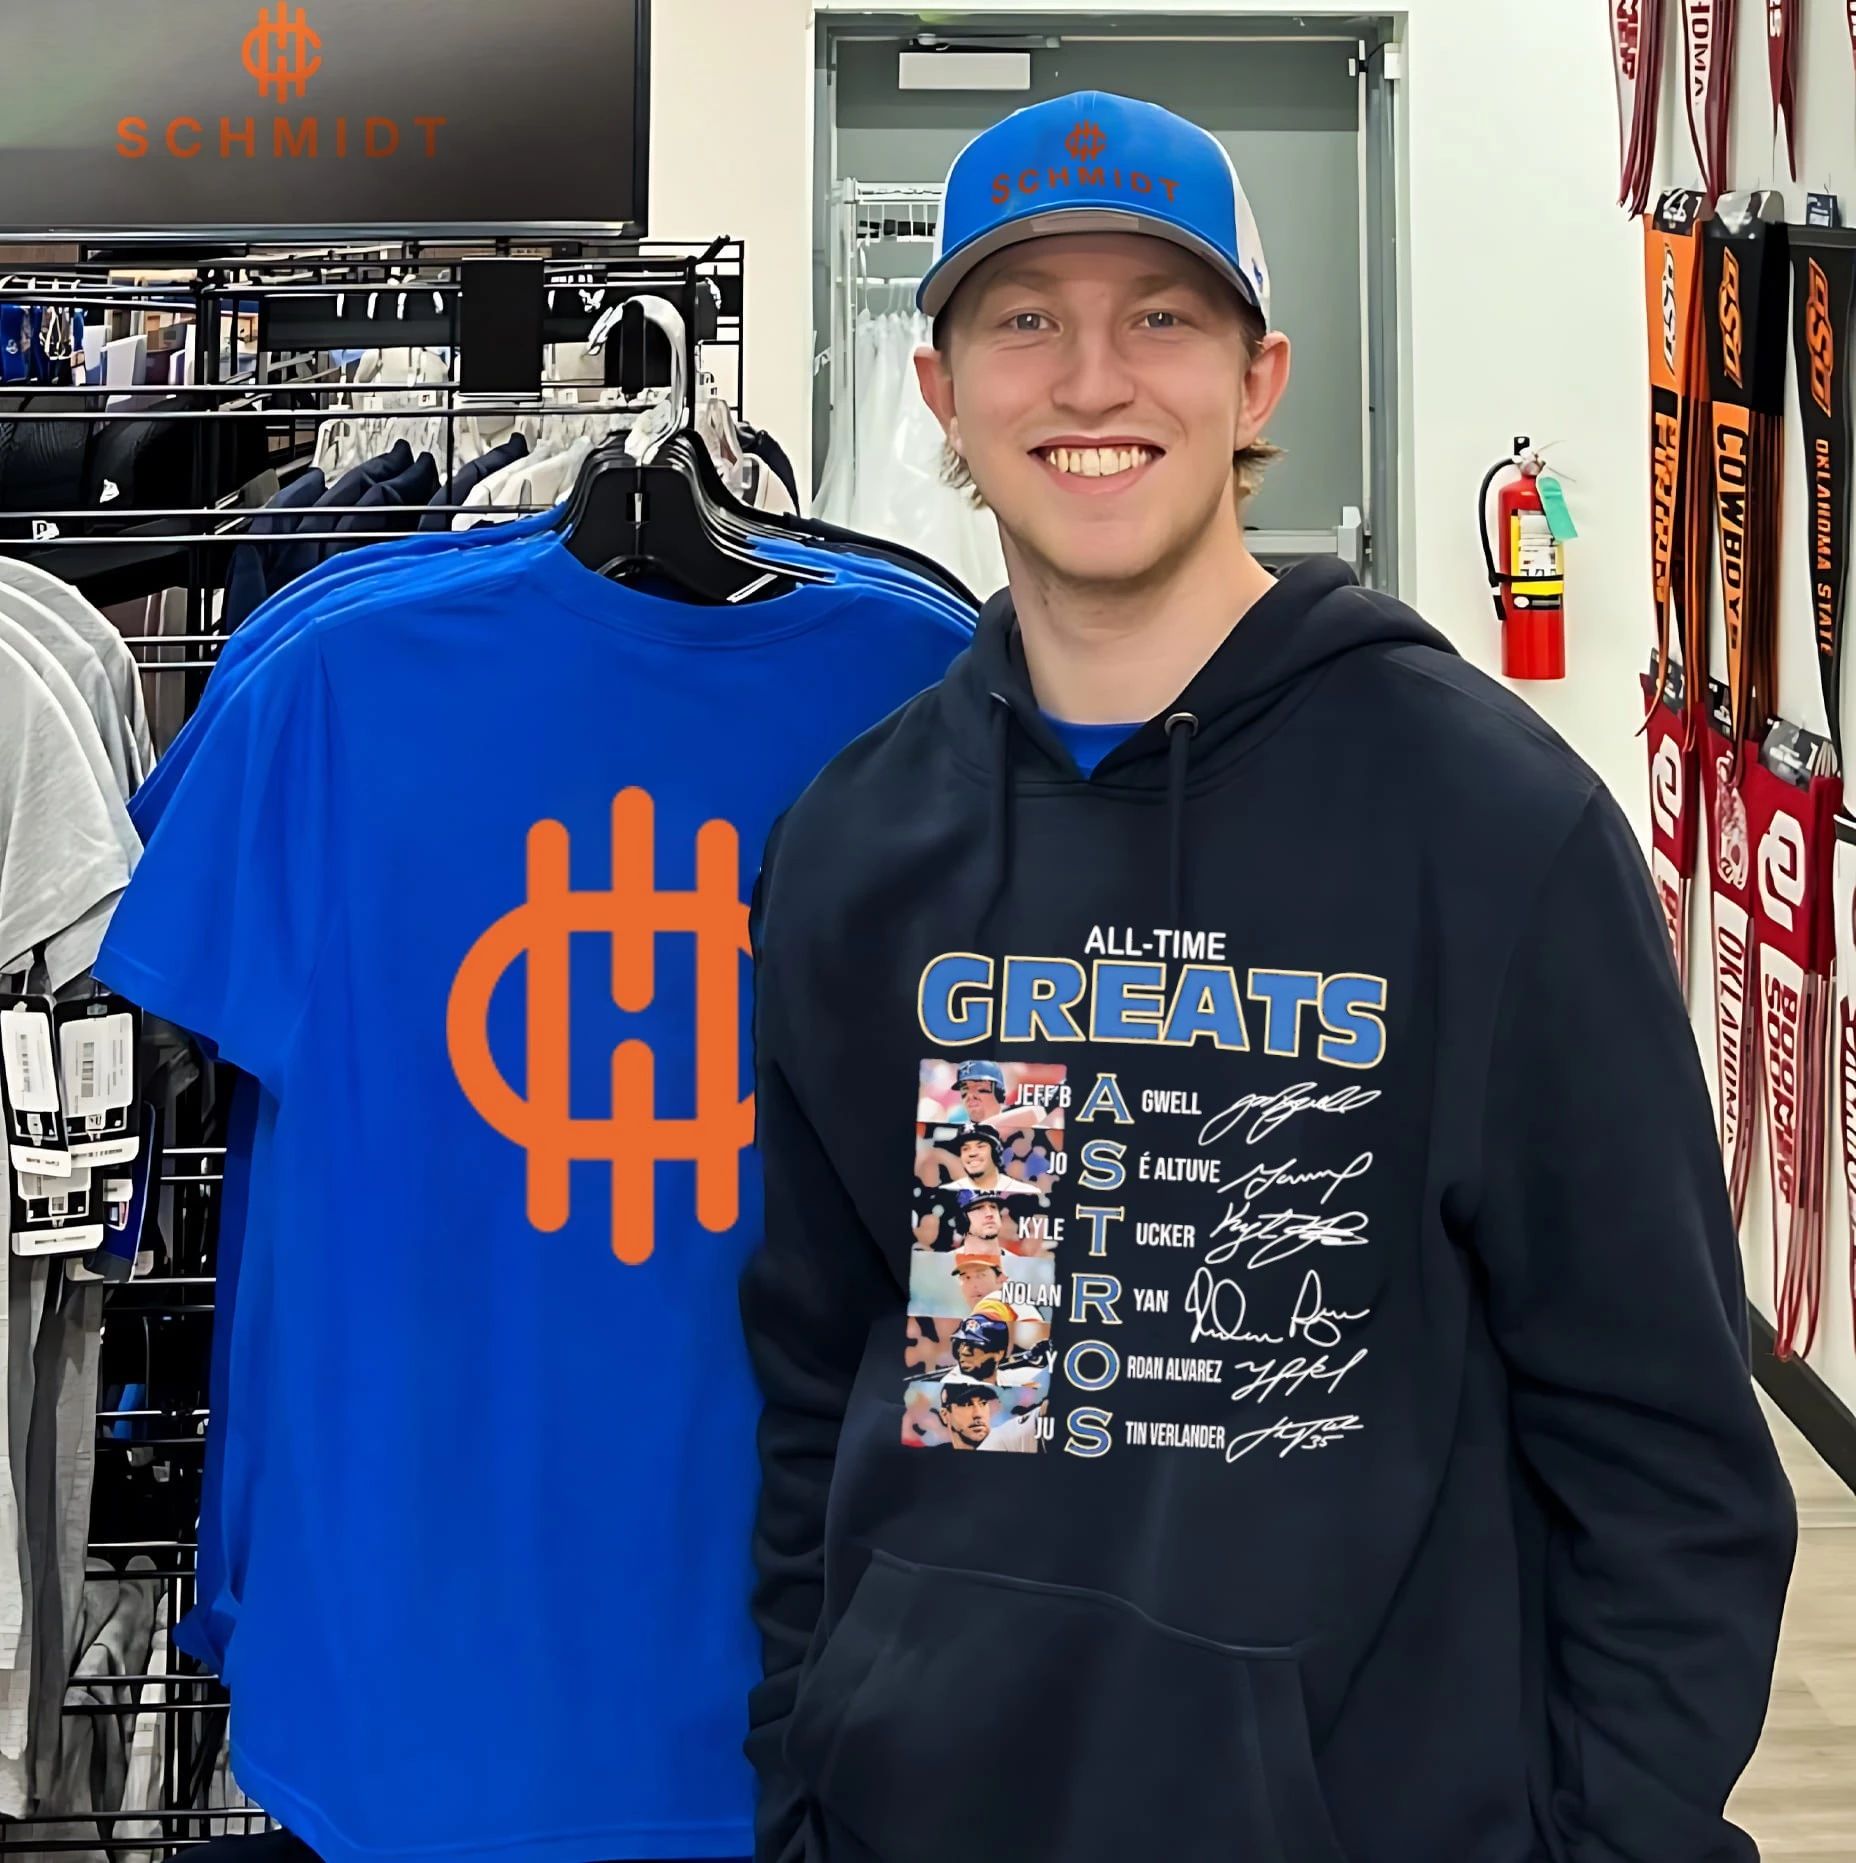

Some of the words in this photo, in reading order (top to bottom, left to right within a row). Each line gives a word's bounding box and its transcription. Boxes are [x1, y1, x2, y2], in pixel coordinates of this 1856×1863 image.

[116, 116, 448, 159] SCHMIDT
[991, 166, 1181, 205] SCHMIDT
[1084, 925, 1227, 961] ALL-TIME
[918, 952, 1388, 1070] GREATS
[1141, 1089, 1202, 1115] GWELL
[1154, 1157, 1221, 1183] ALTUVE
[1018, 1216, 1065, 1241] KYLE
[1136, 1222, 1196, 1248] UCKER
[1001, 1281, 1062, 1308] NOLAN
[1133, 1288, 1169, 1313] YAN
[1127, 1356, 1163, 1380] RDAN
[1165, 1358, 1222, 1383] ALVAREZ
[1125, 1421, 1148, 1445] TIN
[1149, 1423, 1225, 1449] VERLANDER
